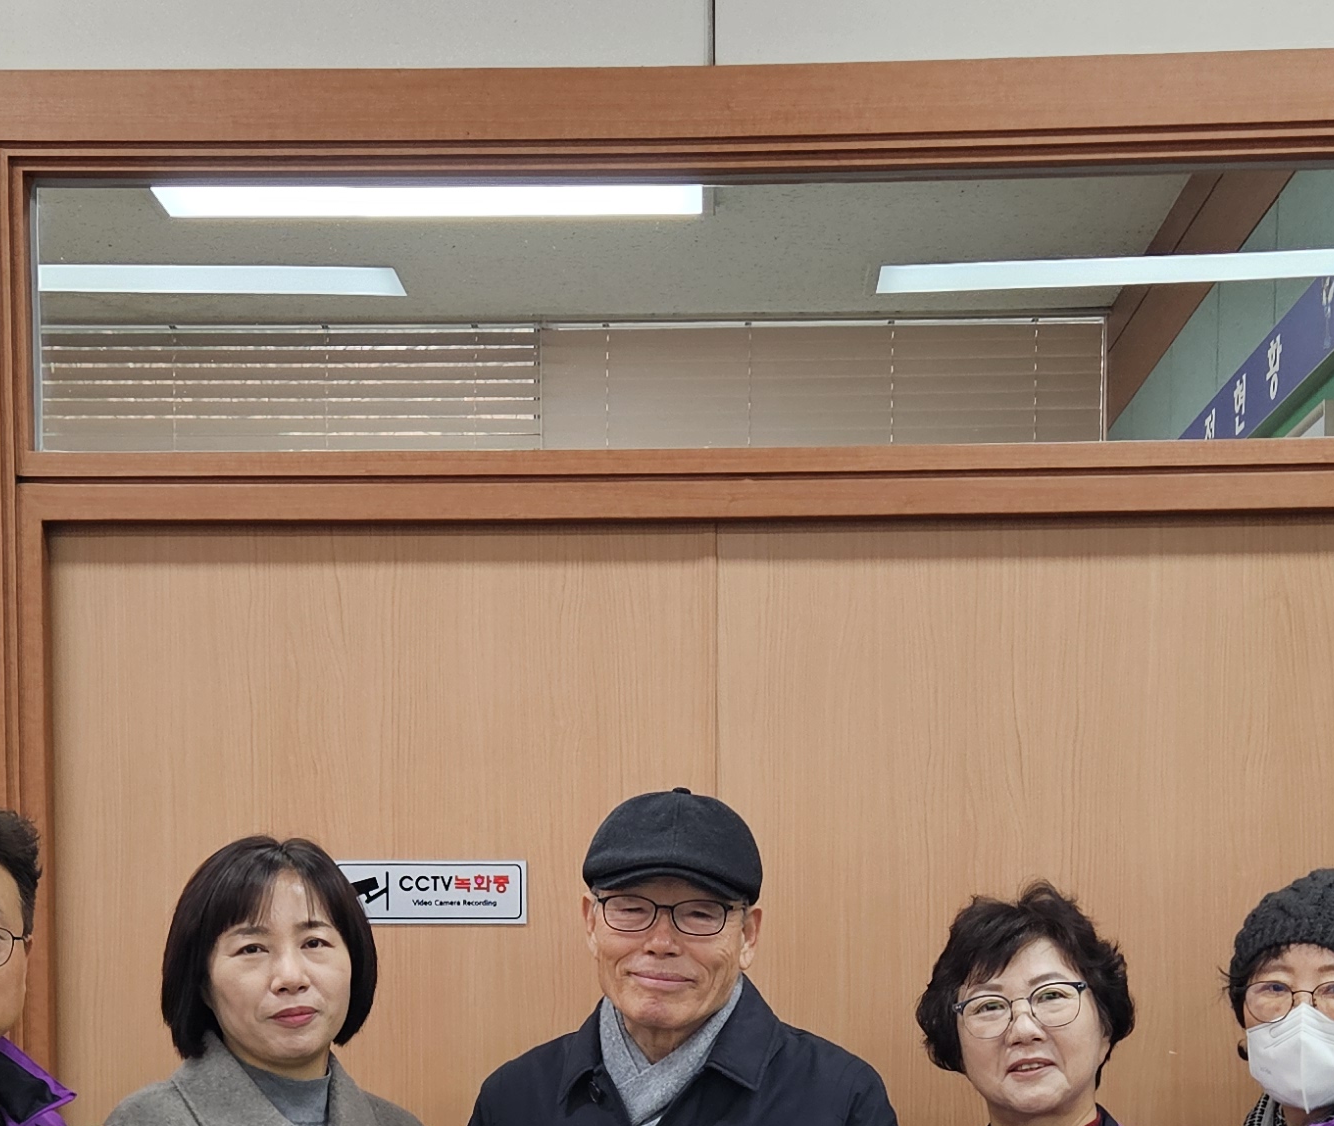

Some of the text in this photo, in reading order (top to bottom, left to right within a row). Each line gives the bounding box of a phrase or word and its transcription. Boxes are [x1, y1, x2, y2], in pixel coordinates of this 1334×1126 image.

[399, 874, 509, 894] CCTV녹화중
[412, 899, 497, 908] Video Camera Recording
